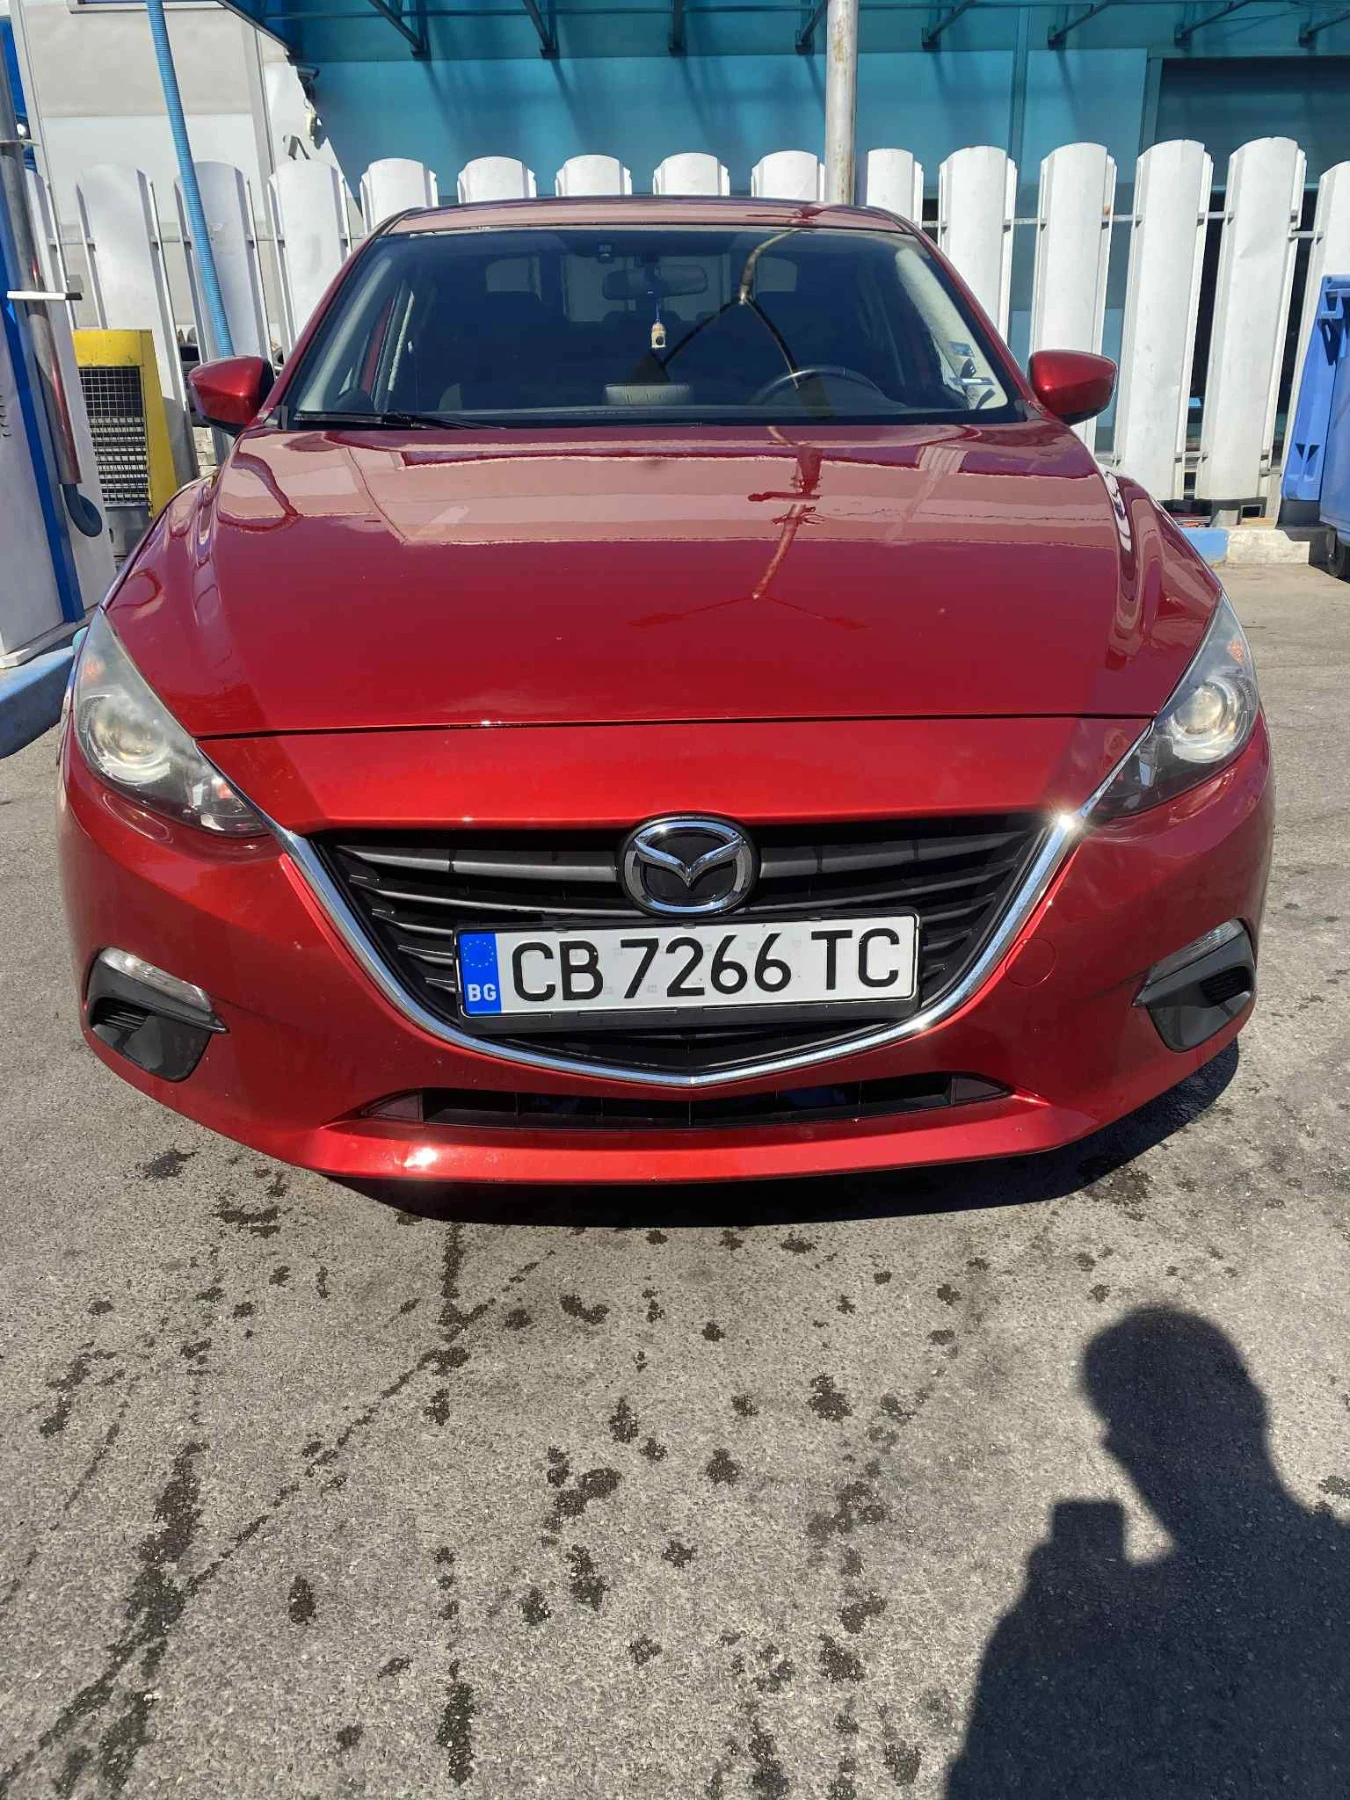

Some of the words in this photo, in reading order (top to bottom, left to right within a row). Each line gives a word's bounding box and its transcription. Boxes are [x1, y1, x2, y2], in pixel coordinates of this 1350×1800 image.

[512, 940, 604, 1001] CB
[620, 933, 792, 999] 7266
[811, 928, 900, 990] TC
[467, 983, 497, 1002] BG
